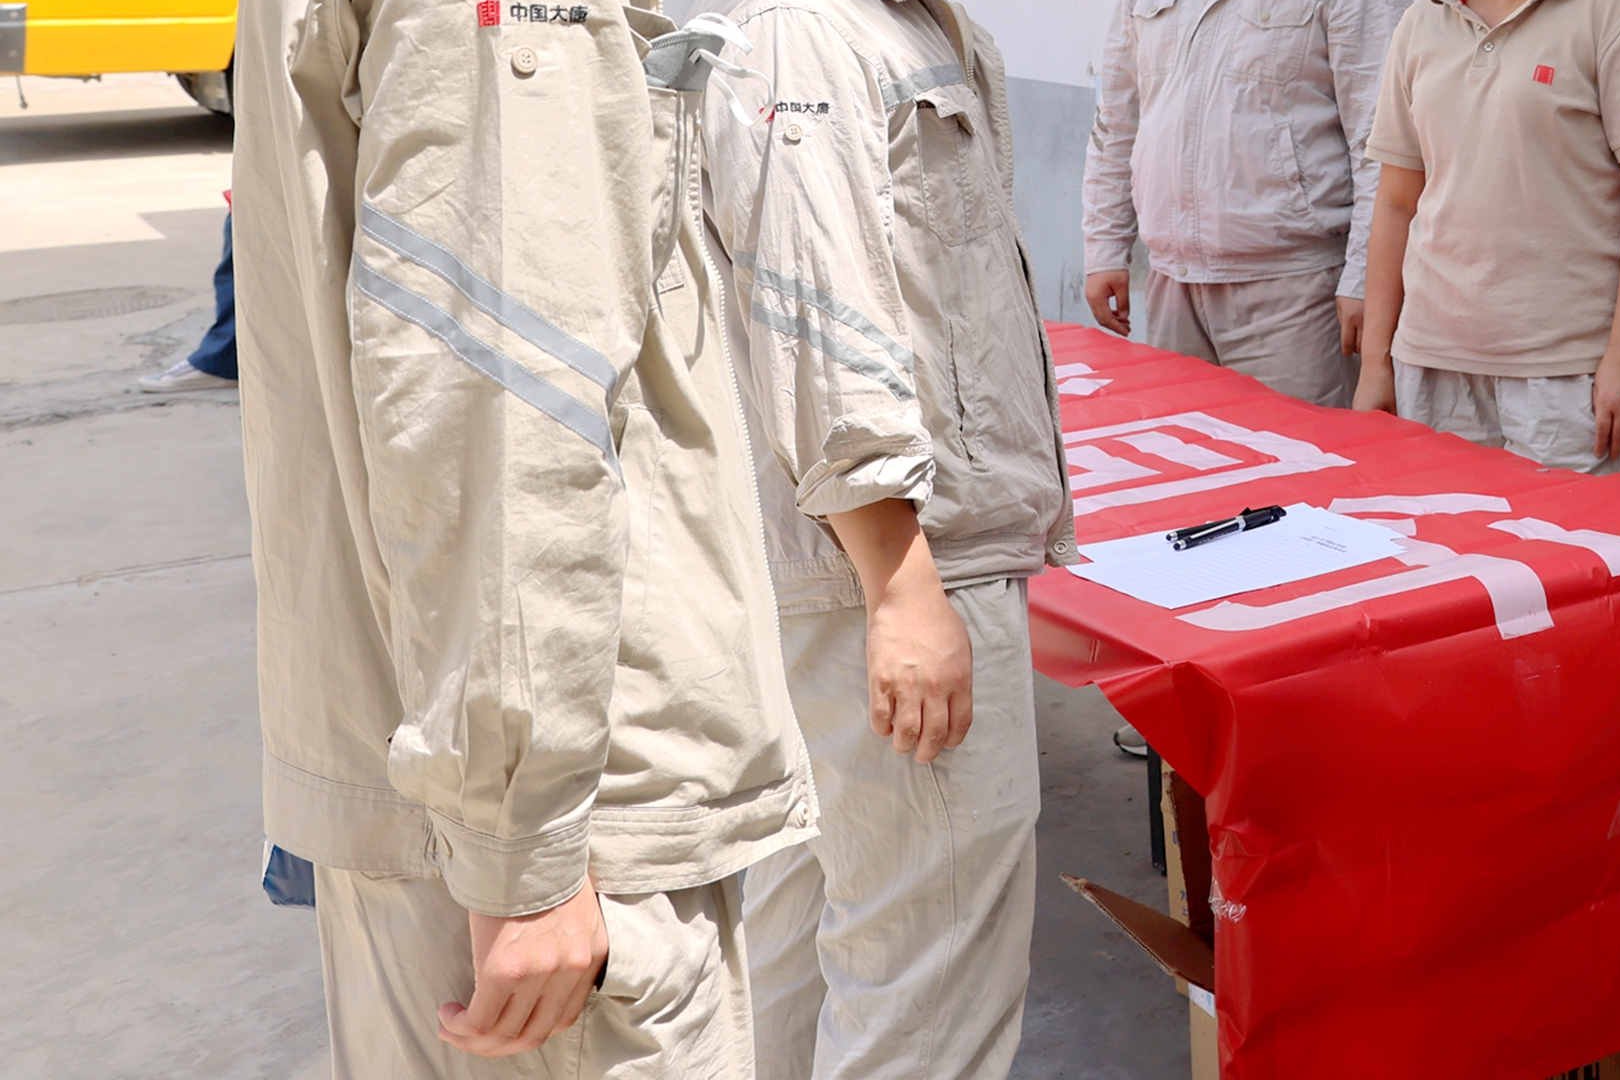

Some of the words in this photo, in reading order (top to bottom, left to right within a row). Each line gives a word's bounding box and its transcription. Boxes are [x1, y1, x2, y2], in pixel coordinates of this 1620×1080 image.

[510, 2, 588, 24] 中国大唐
[775, 101, 829, 114] 中国大唐
